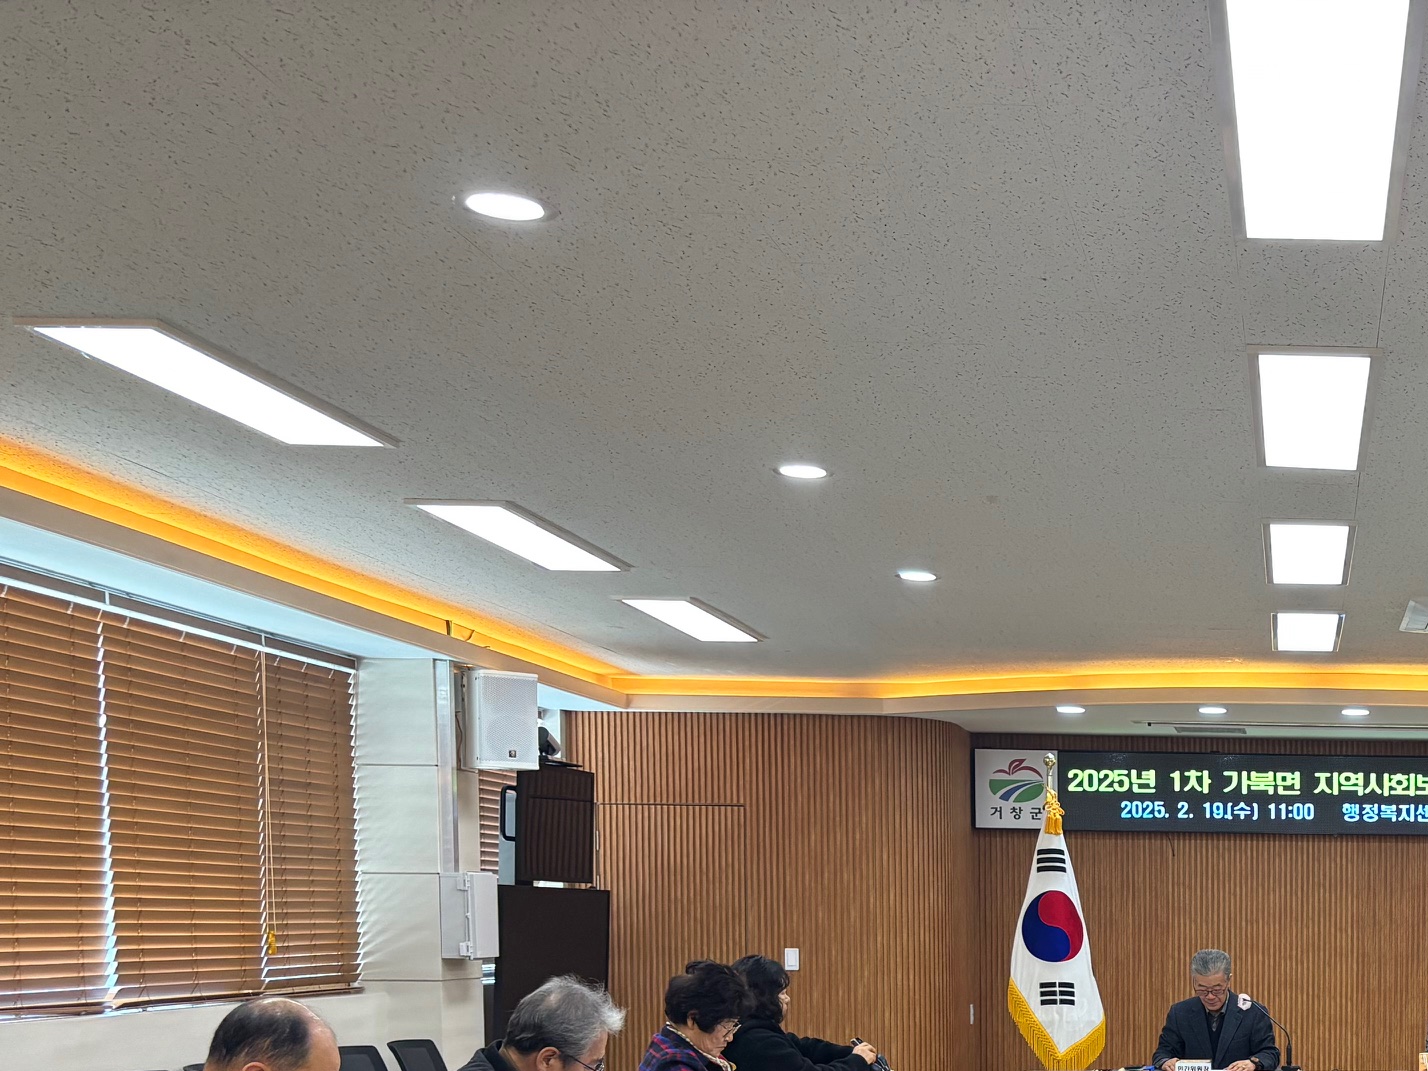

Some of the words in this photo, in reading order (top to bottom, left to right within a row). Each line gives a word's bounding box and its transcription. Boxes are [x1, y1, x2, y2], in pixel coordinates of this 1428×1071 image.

[1067, 768, 1157, 794] 2025년
[1169, 769, 1212, 794] 1차
[1222, 770, 1301, 796] 가북면
[990, 806, 1043, 820] 거창군
[1120, 800, 1170, 819] 2025.
[1177, 801, 1194, 819] 2.
[1267, 802, 1315, 821] 11:00
